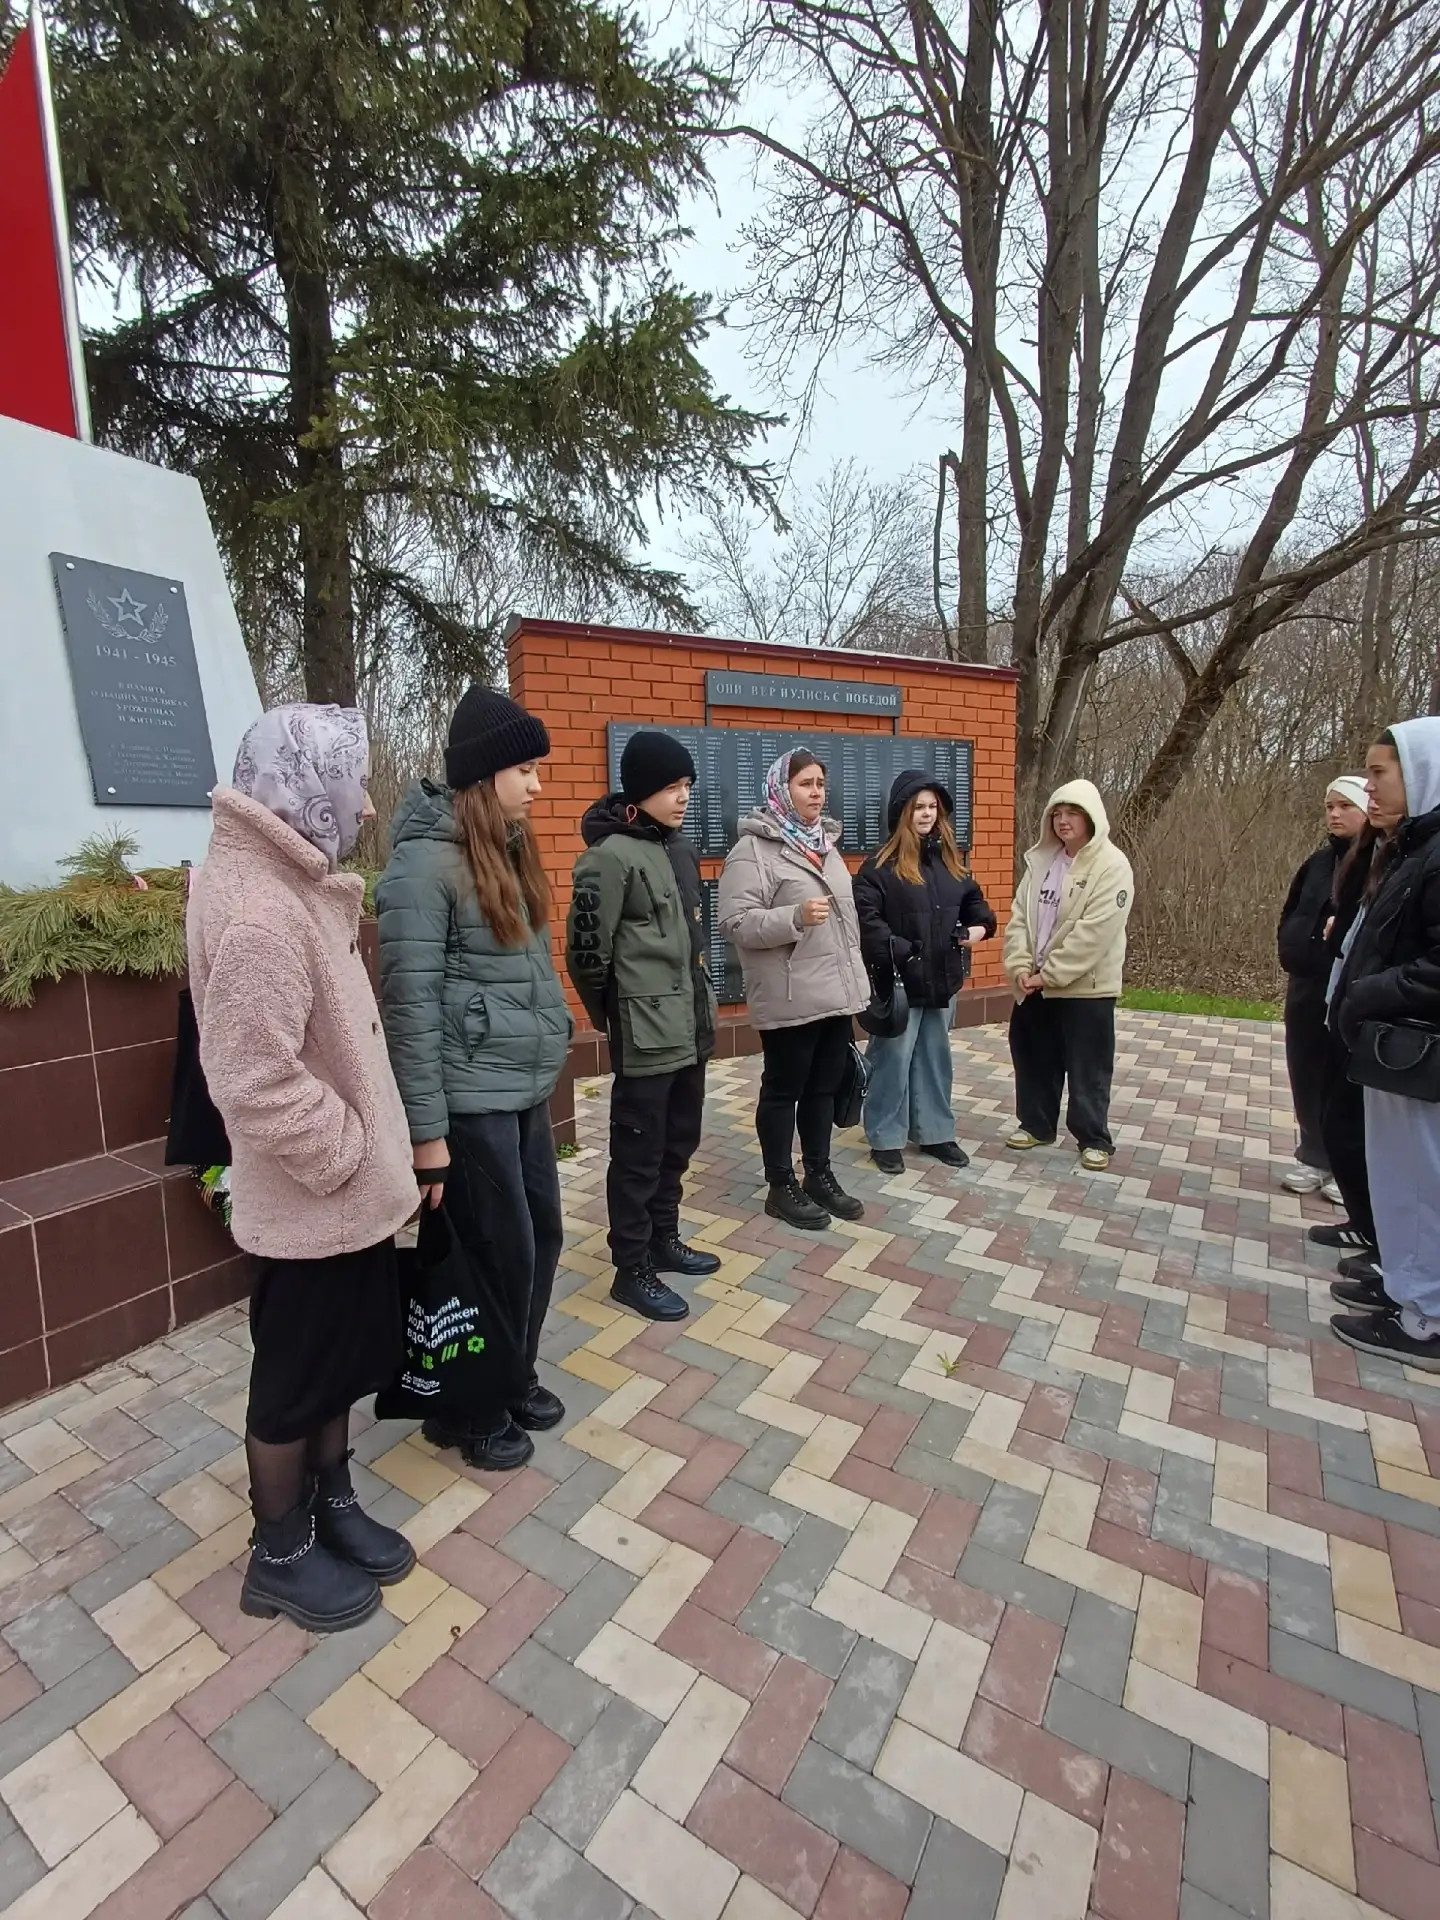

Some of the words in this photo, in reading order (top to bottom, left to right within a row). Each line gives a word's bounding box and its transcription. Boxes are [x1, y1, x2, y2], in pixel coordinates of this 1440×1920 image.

[96, 644, 127, 659] 1941
[145, 651, 176, 667] 1945
[716, 683, 742, 695] ОНИ
[846, 692, 897, 706] ПОБЕДОЙ
[430, 1305, 480, 1339] должен
